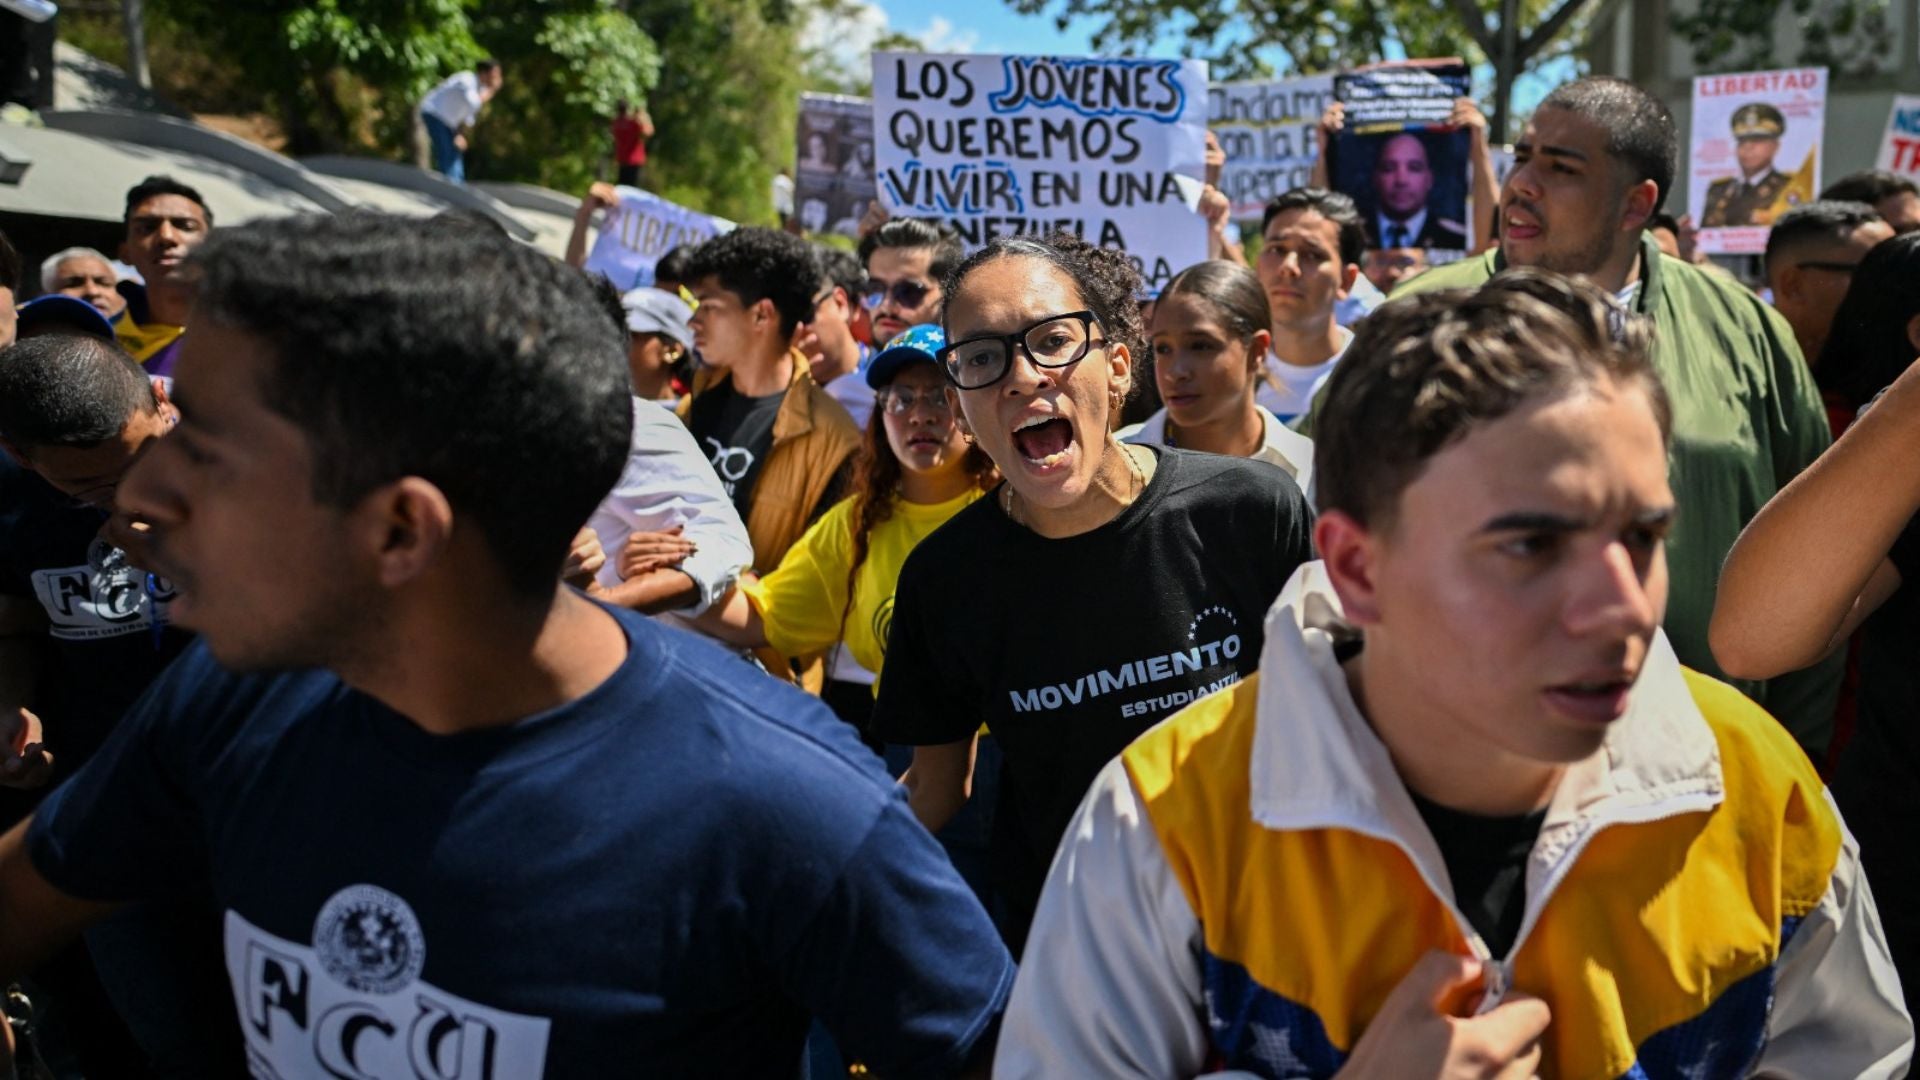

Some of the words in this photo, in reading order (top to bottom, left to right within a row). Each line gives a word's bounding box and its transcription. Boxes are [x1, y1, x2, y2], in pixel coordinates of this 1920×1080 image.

[896, 58, 975, 107] LOS
[1701, 71, 1818, 97] LIBERTAD
[889, 108, 1140, 163] QUEREMOS
[886, 168, 1016, 212] VIVIR
[1031, 170, 1081, 207] EN
[1099, 170, 1186, 208] UNA
[620, 207, 710, 257] LIBE
[892, 216, 1127, 252] NEZULA
[1009, 634, 1241, 713] MOVIMIENTO
[1121, 672, 1241, 719] ESTUDIANTIL
